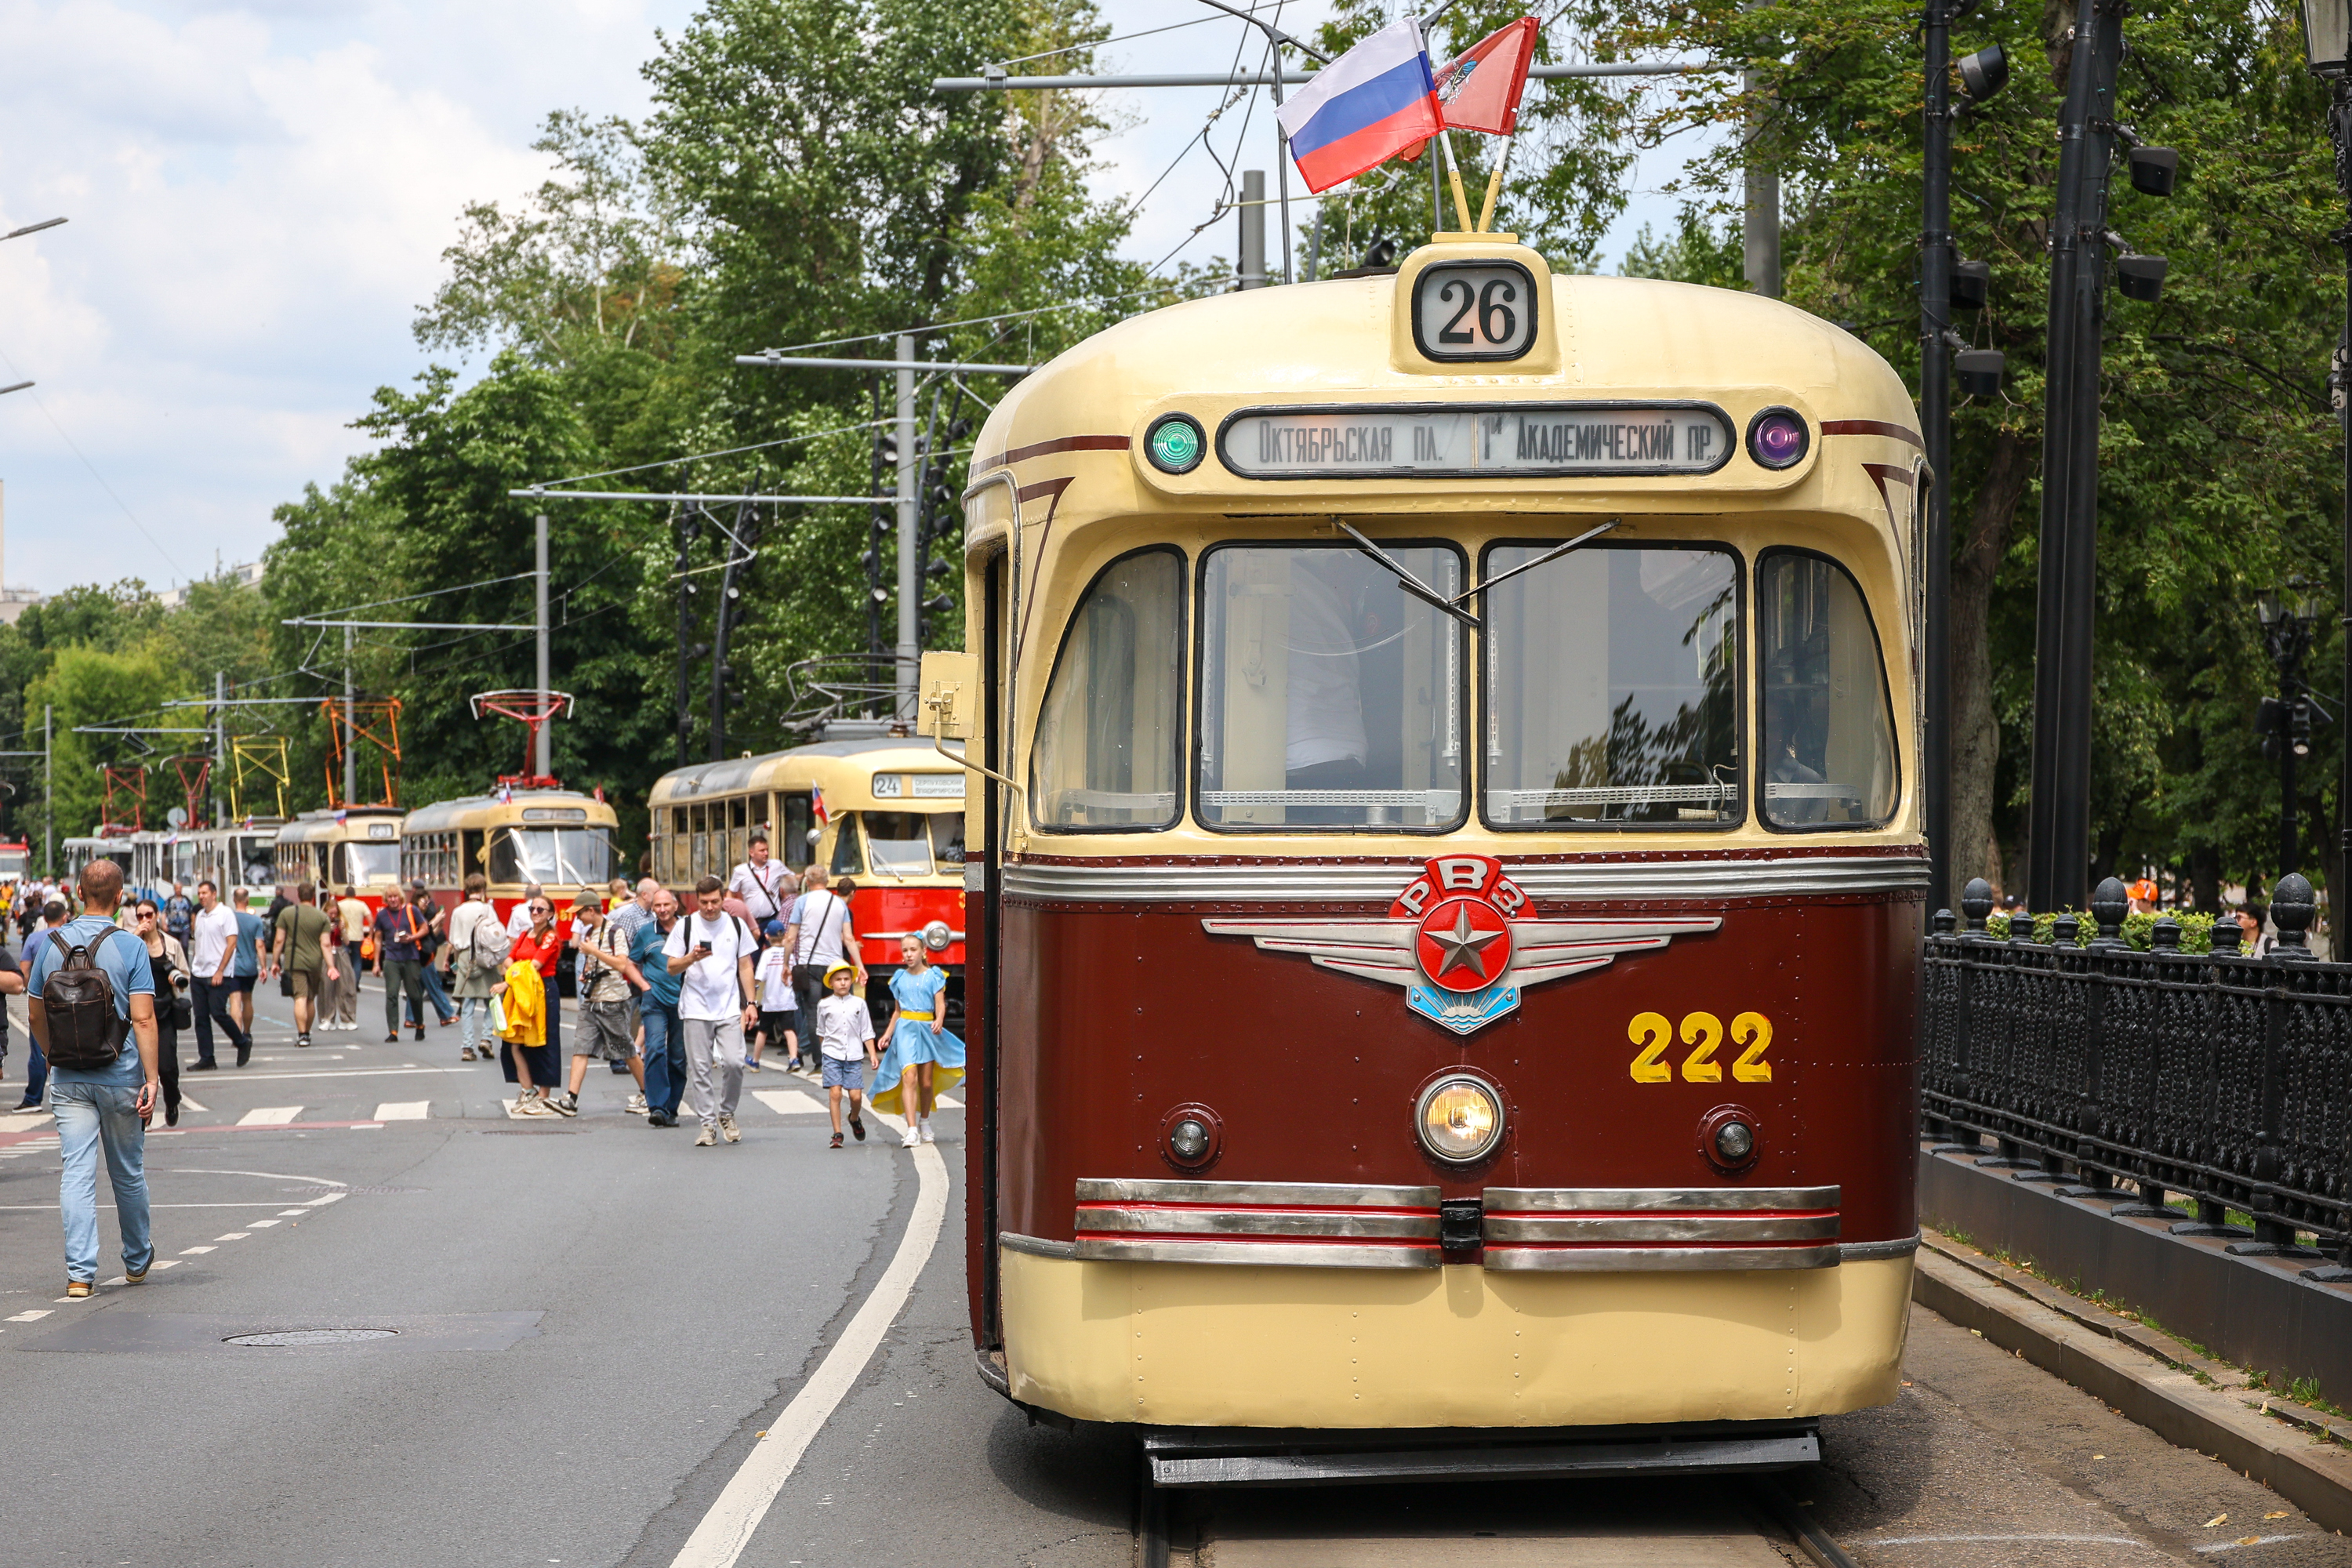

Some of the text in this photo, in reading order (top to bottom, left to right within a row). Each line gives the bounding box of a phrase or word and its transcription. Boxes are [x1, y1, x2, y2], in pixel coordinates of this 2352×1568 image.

[1439, 279, 1516, 344] 26
[876, 778, 898, 794] 24
[1399, 859, 1526, 915] РВЗ
[1628, 1011, 1773, 1083] 222
